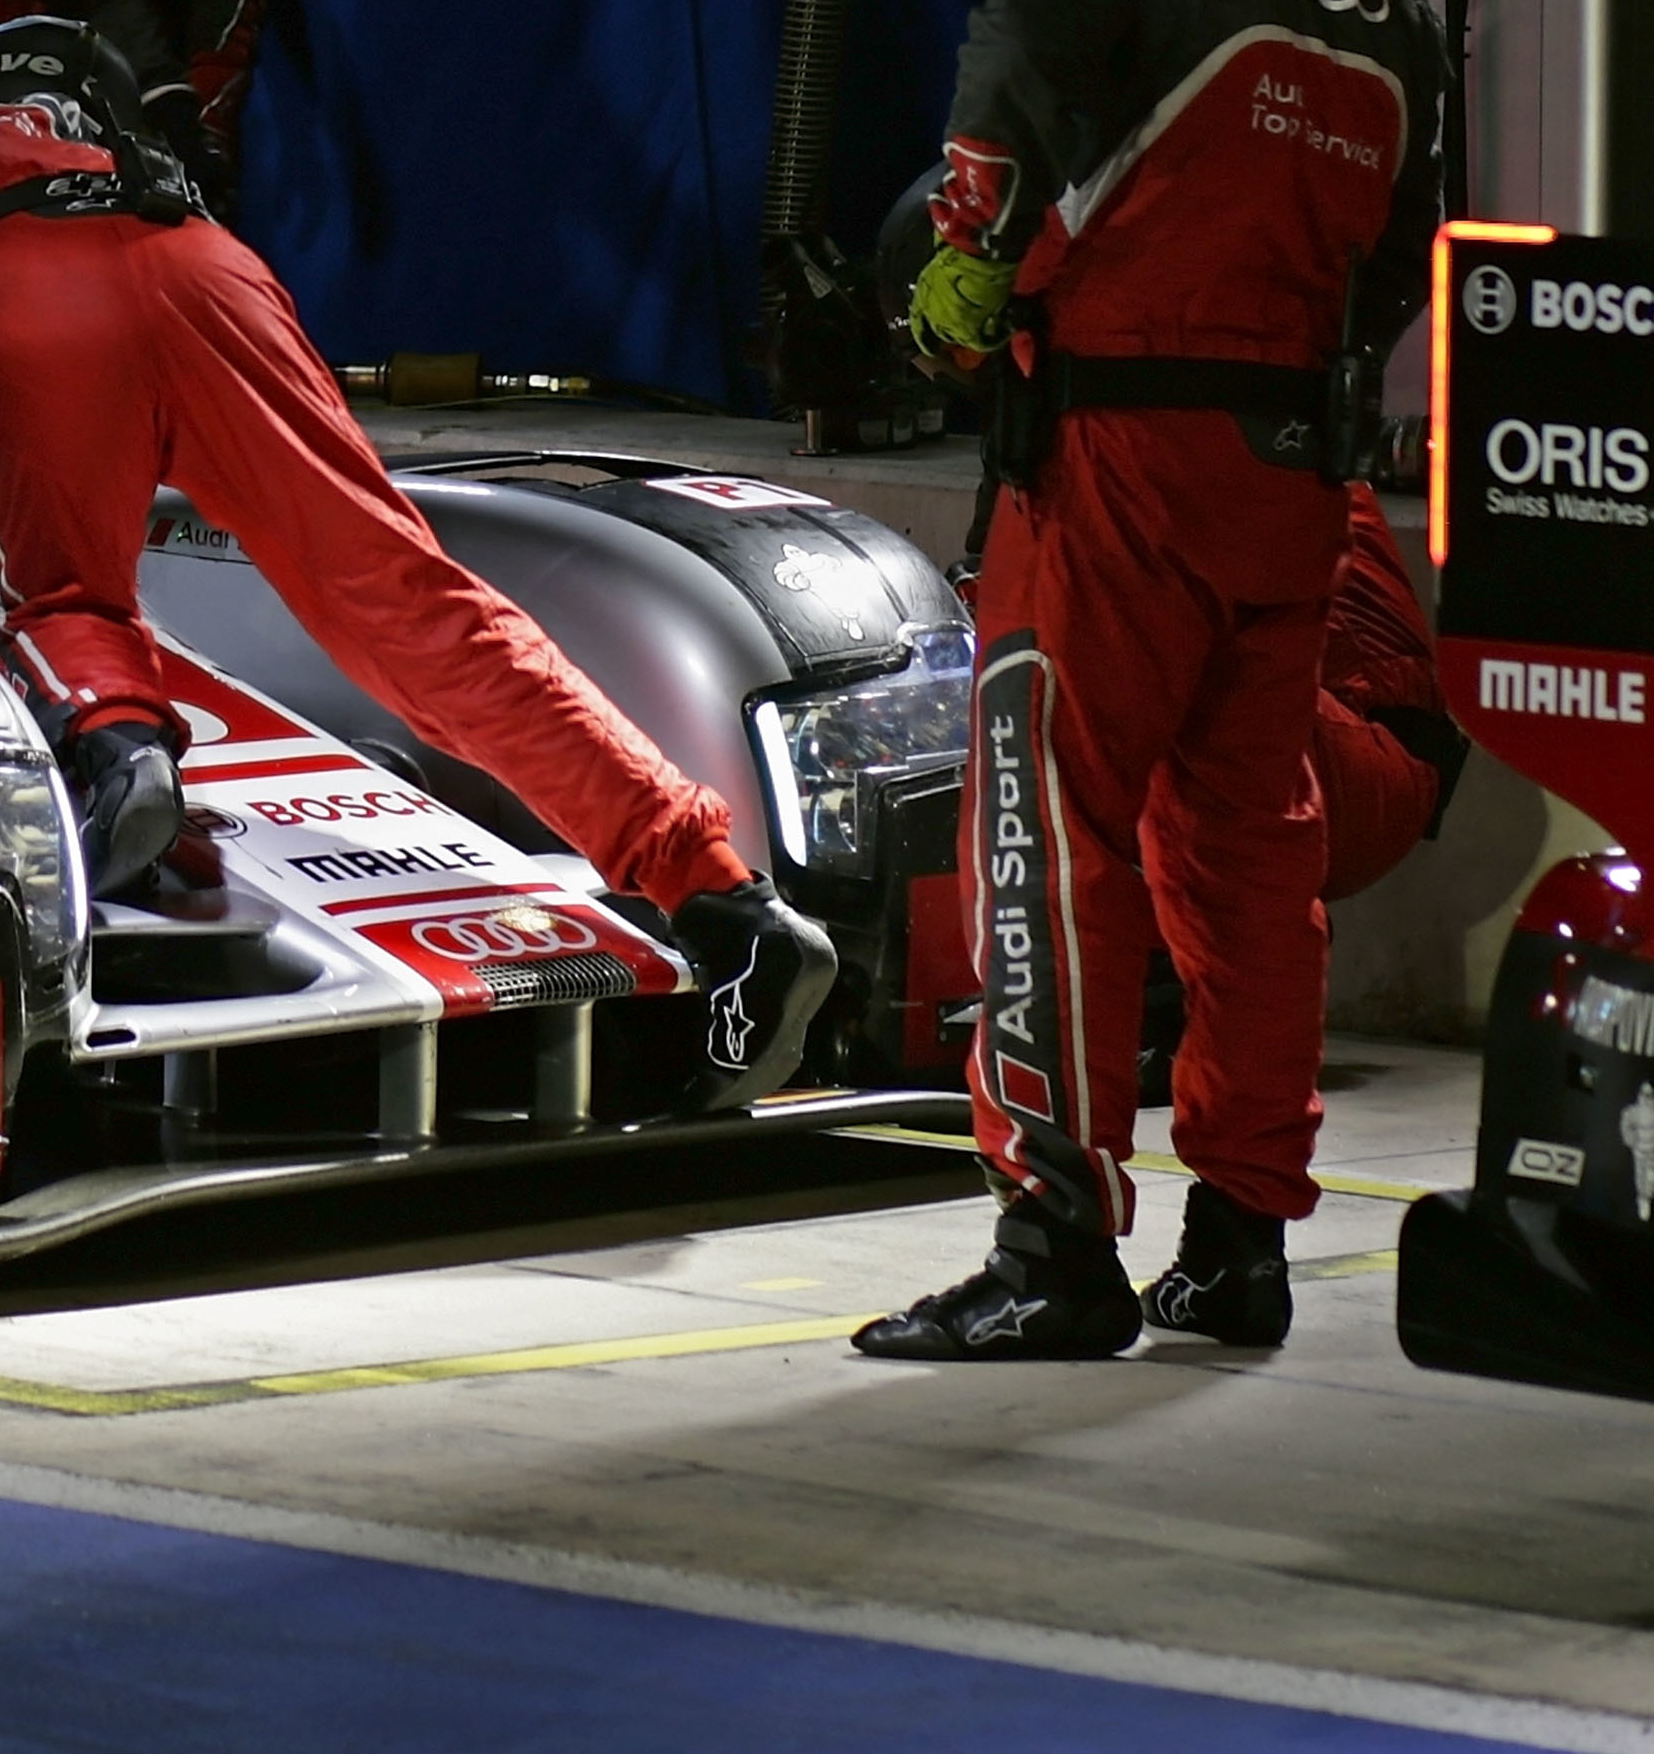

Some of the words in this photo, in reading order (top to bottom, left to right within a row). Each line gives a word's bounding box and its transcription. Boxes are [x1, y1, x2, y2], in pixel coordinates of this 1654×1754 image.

[1530, 278, 1654, 337] BOSC
[1485, 417, 1651, 494] ORIS
[175, 521, 231, 550] Audi
[1487, 486, 1551, 520] Swiss
[1553, 492, 1649, 529] Watches
[1478, 657, 1647, 725] MAHLE
[247, 790, 455, 827] BOSCH
[990, 713, 1034, 889] Sport
[286, 842, 496, 885] MAHLE
[994, 905, 1036, 1046] Audi
